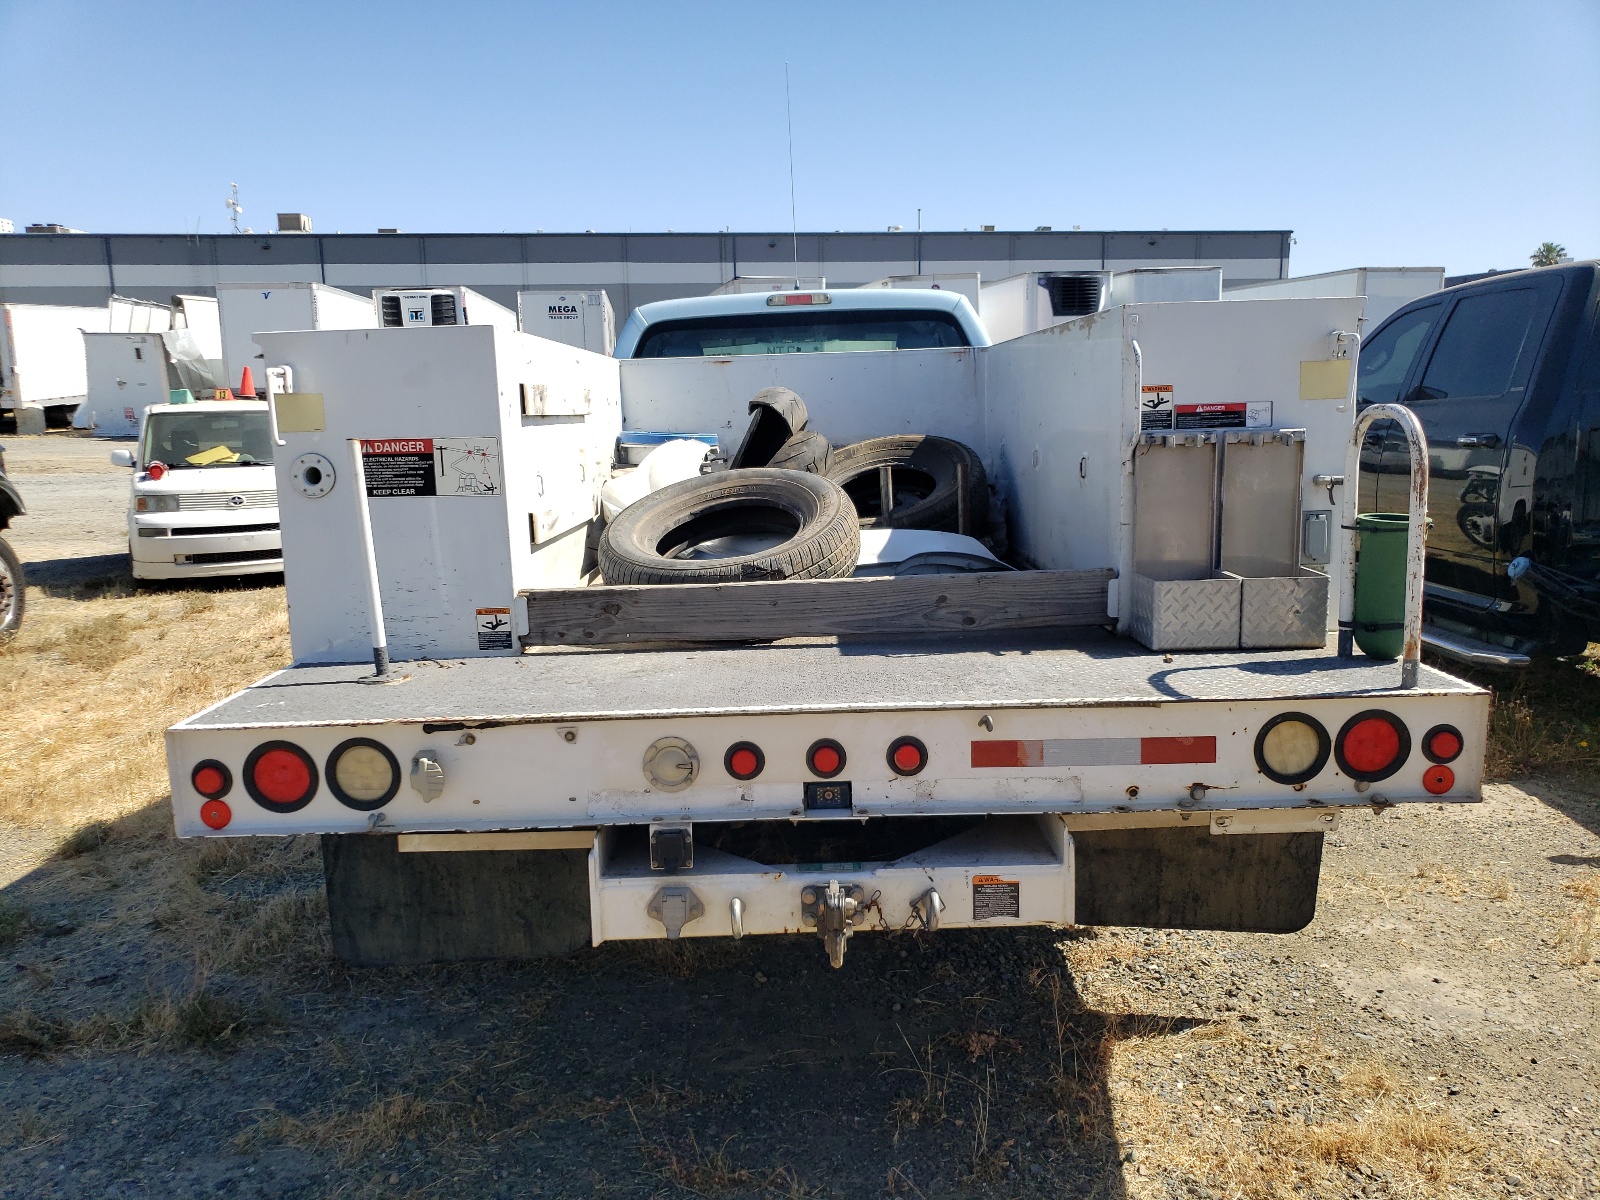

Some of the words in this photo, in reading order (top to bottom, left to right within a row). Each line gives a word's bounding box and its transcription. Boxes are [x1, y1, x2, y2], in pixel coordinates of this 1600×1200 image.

[548, 305, 578, 314] MEGA
[218, 390, 226, 400] 13
[374, 441, 425, 453] DANGER
